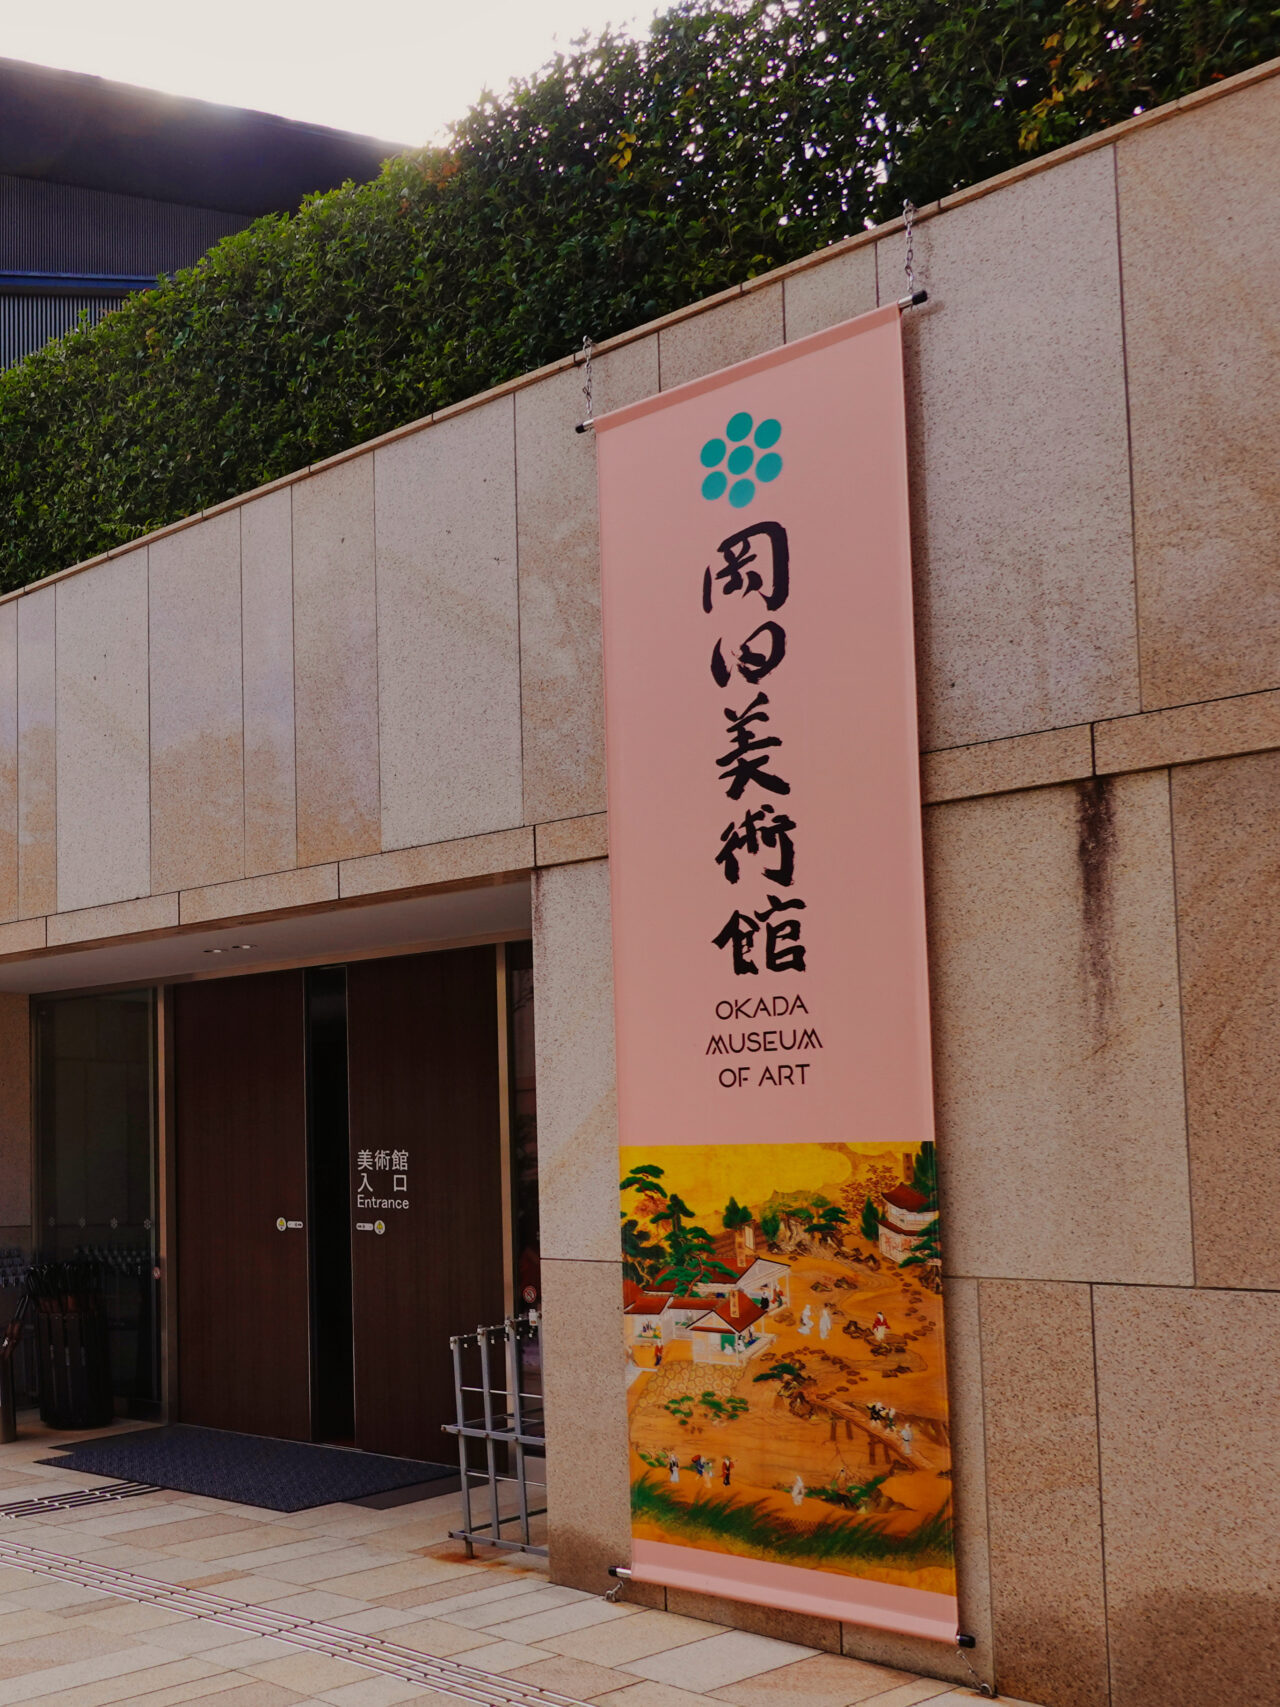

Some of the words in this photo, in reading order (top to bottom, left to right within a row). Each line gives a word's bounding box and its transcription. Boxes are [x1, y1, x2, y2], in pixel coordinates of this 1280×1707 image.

[703, 521, 807, 975] 岡田美術館
[715, 994, 809, 1020] OKADA
[705, 1028, 823, 1055] MUSEUM
[719, 1066, 751, 1088] OF
[758, 1063, 811, 1087] ART
[357, 1149, 409, 1171] 美術館
[357, 1194, 410, 1209] Entrance
